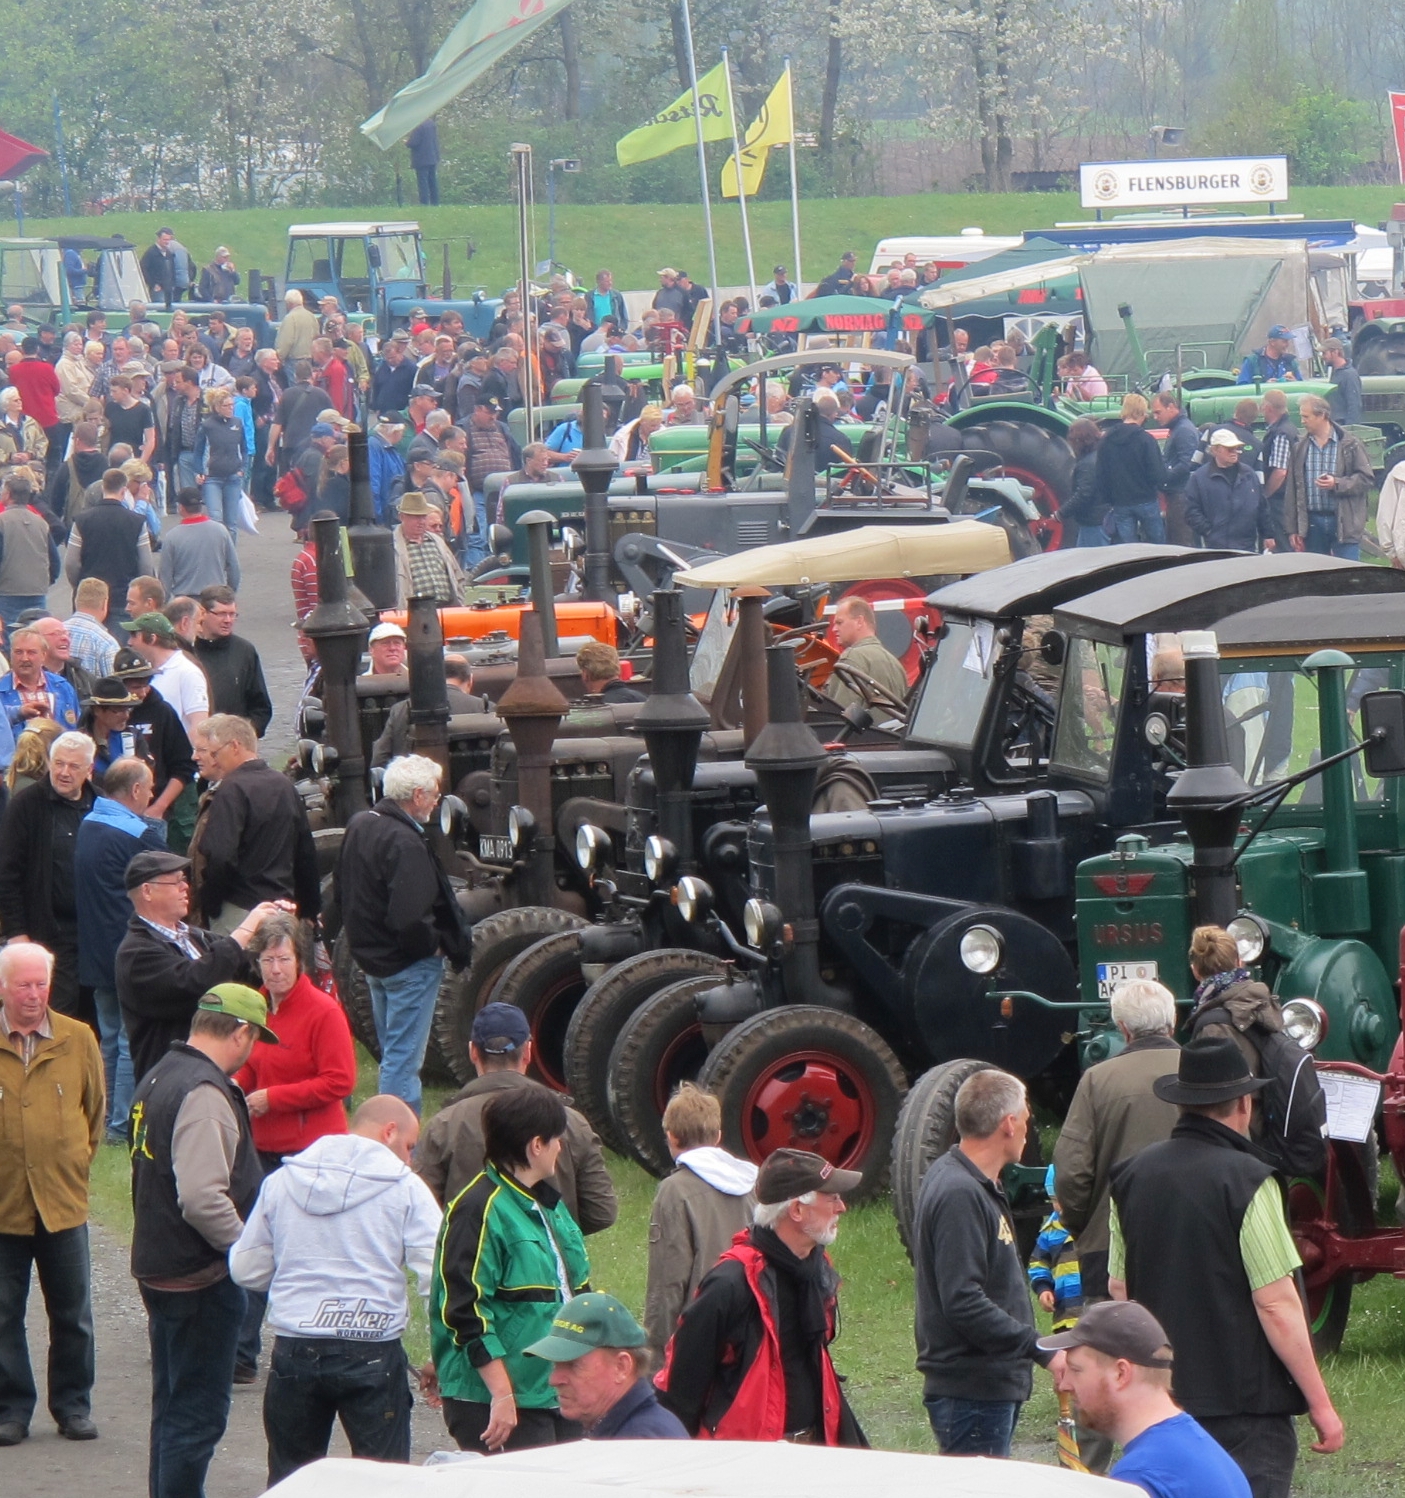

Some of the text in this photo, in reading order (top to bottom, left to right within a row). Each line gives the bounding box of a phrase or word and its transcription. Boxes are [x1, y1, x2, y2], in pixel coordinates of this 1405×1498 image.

[1129, 174, 1241, 192] FLENSBURGER
[825, 313, 885, 331] NORMAG
[1093, 922, 1163, 945] URSUS
[1110, 965, 1127, 980] PI
